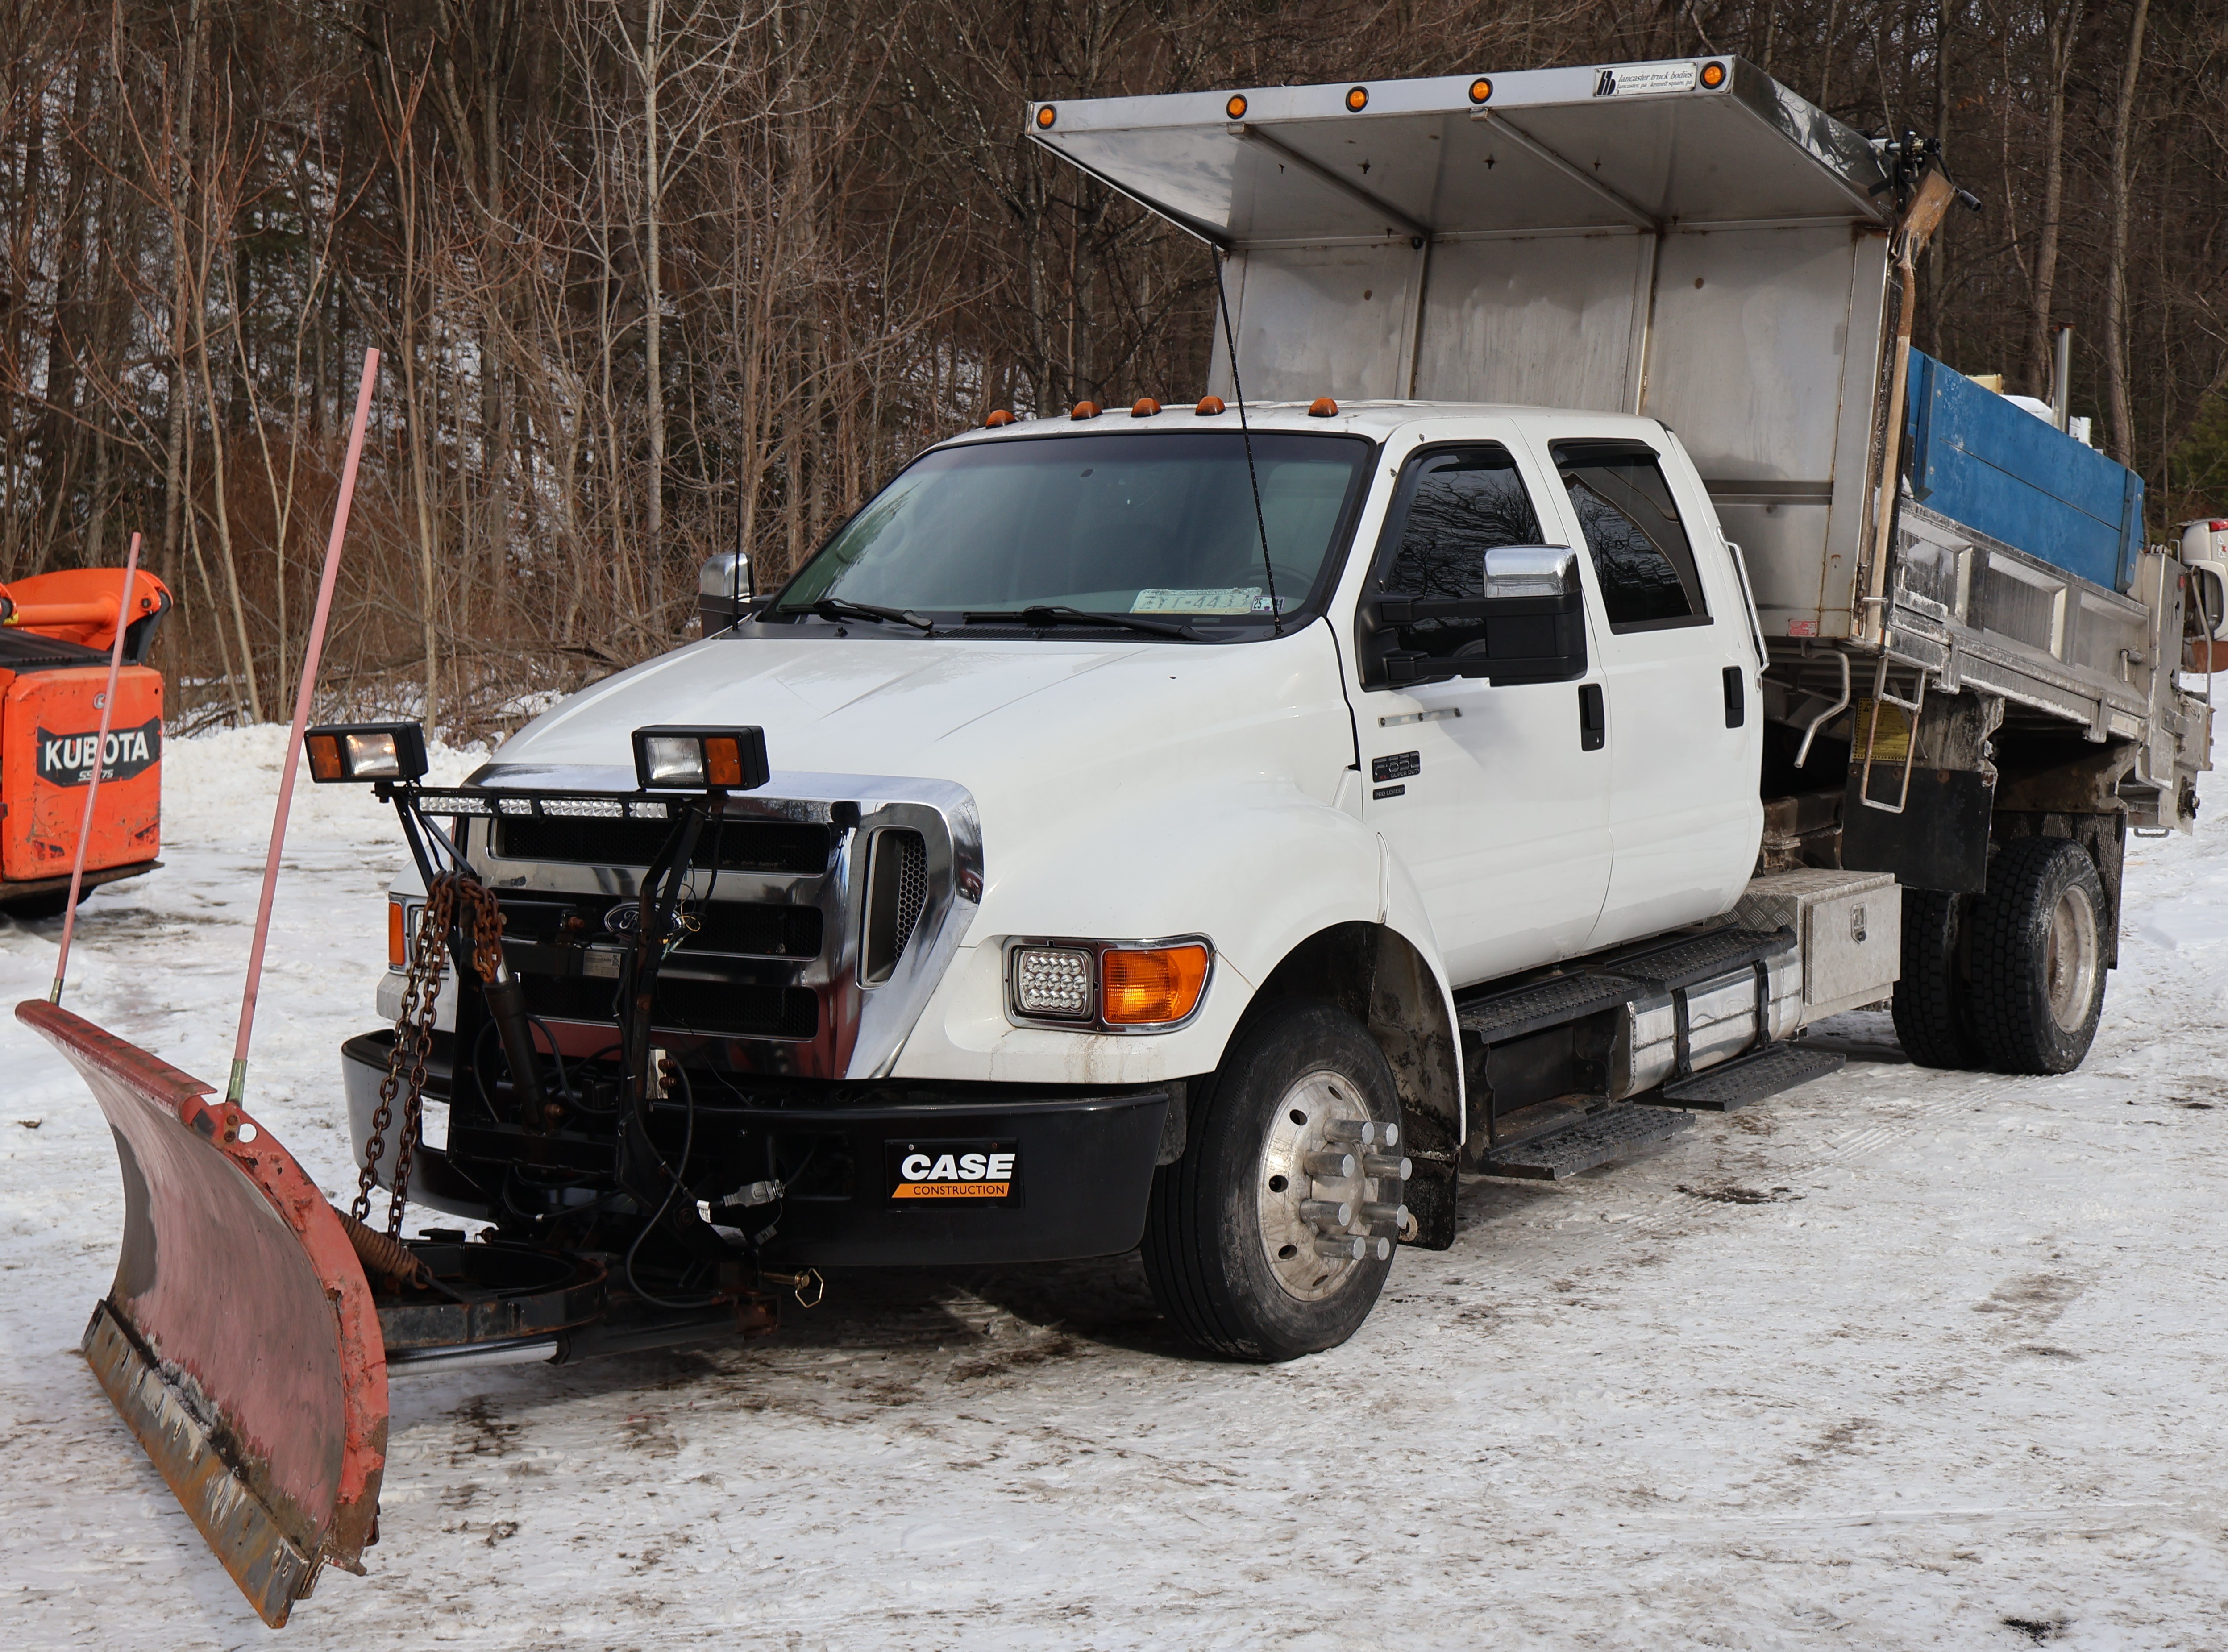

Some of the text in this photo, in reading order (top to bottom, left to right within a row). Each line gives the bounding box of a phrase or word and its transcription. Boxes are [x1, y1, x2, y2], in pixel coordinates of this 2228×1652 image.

[1618, 71, 1693, 82] lancaster truck bodies
[1254, 598, 1263, 609] 25
[46, 731, 150, 772] KUBOTA
[77, 769, 114, 781] SS75
[1386, 787, 1405, 795] LOADER
[902, 1153, 1015, 1181] CASE
[913, 1185, 1004, 1195] CONSTRUCTION
